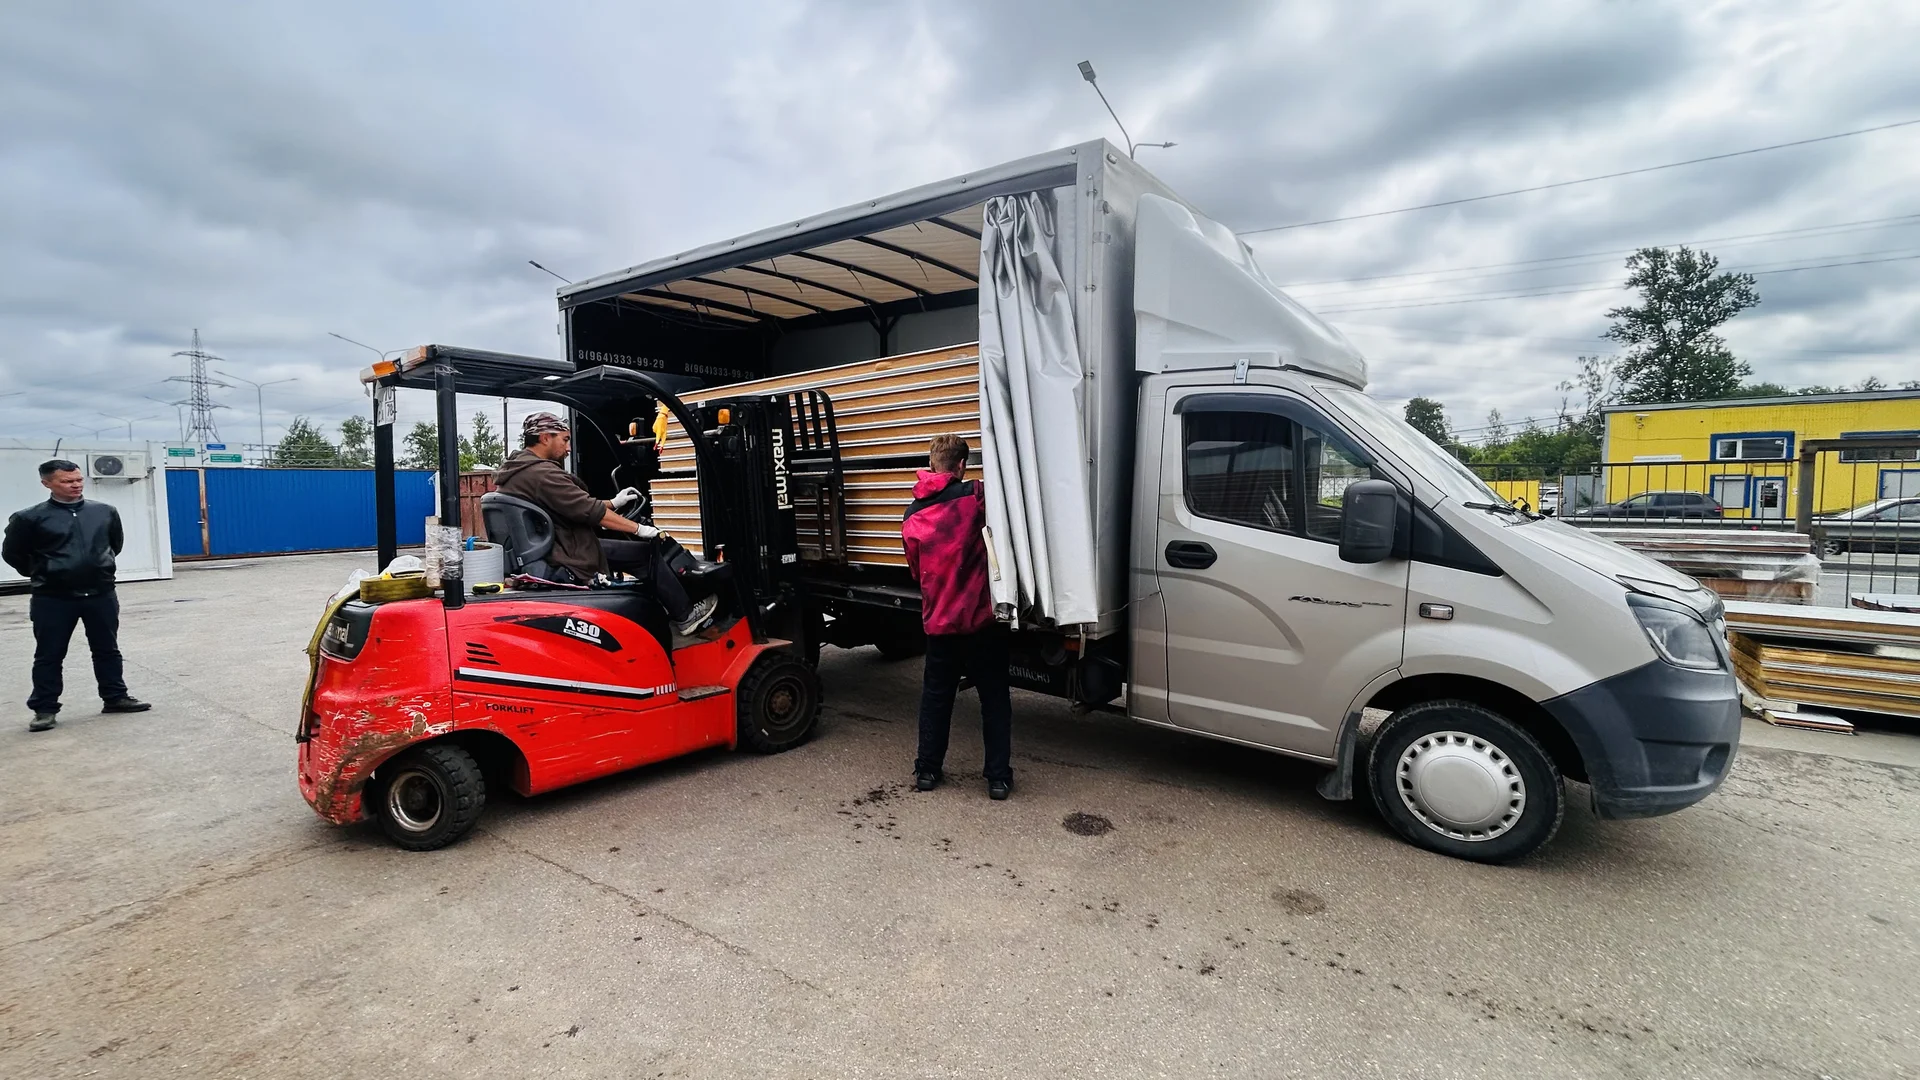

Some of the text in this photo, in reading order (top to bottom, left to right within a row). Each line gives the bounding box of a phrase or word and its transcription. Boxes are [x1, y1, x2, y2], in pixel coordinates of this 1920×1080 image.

[578, 349, 665, 369] 8(964)333-99-29
[772, 428, 794, 510] maximal
[565, 618, 601, 638] A30
[1008, 664, 1051, 684] ЕОПАСНО
[485, 702, 535, 715] FORKLIFT
